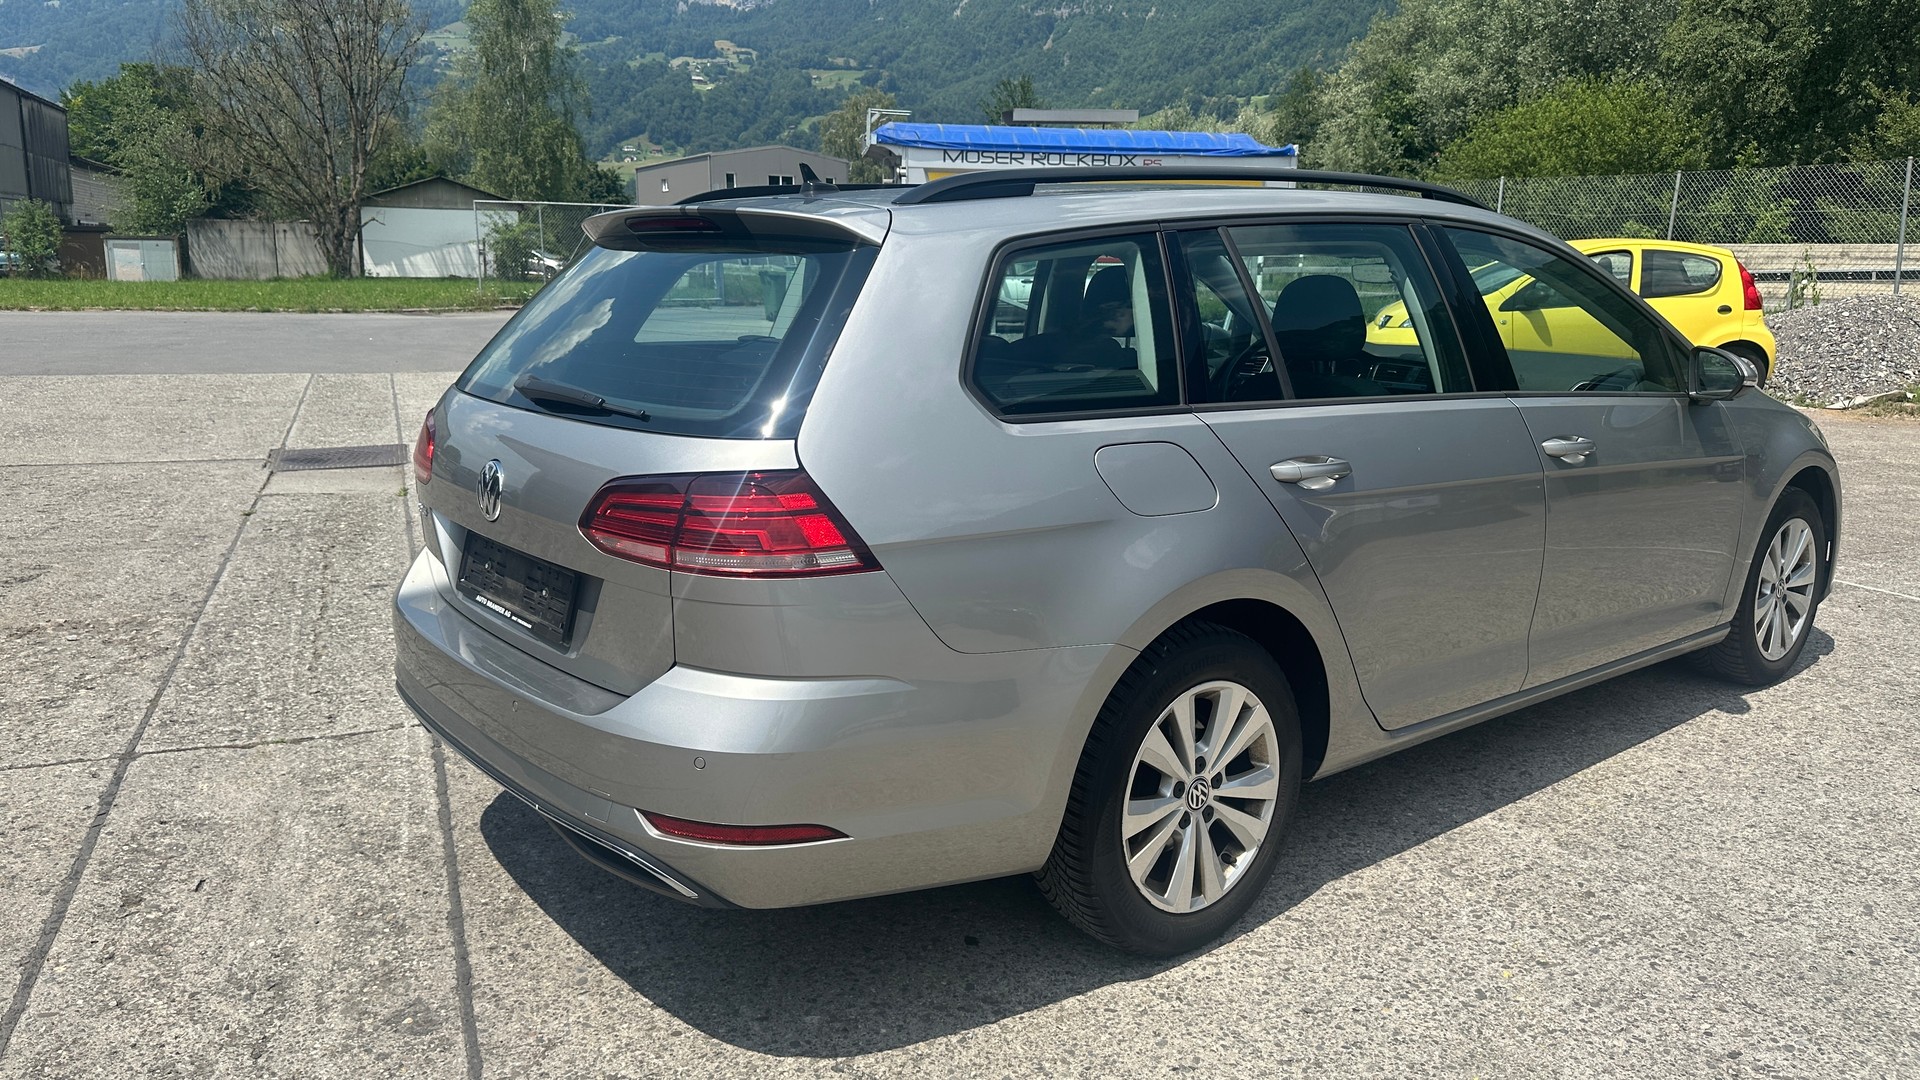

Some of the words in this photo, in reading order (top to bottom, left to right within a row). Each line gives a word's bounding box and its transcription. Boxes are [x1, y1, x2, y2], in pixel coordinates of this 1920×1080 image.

[943, 149, 1025, 165] MOSER
[1031, 152, 1136, 167] ROCKBOX
[504, 610, 512, 618] AG
